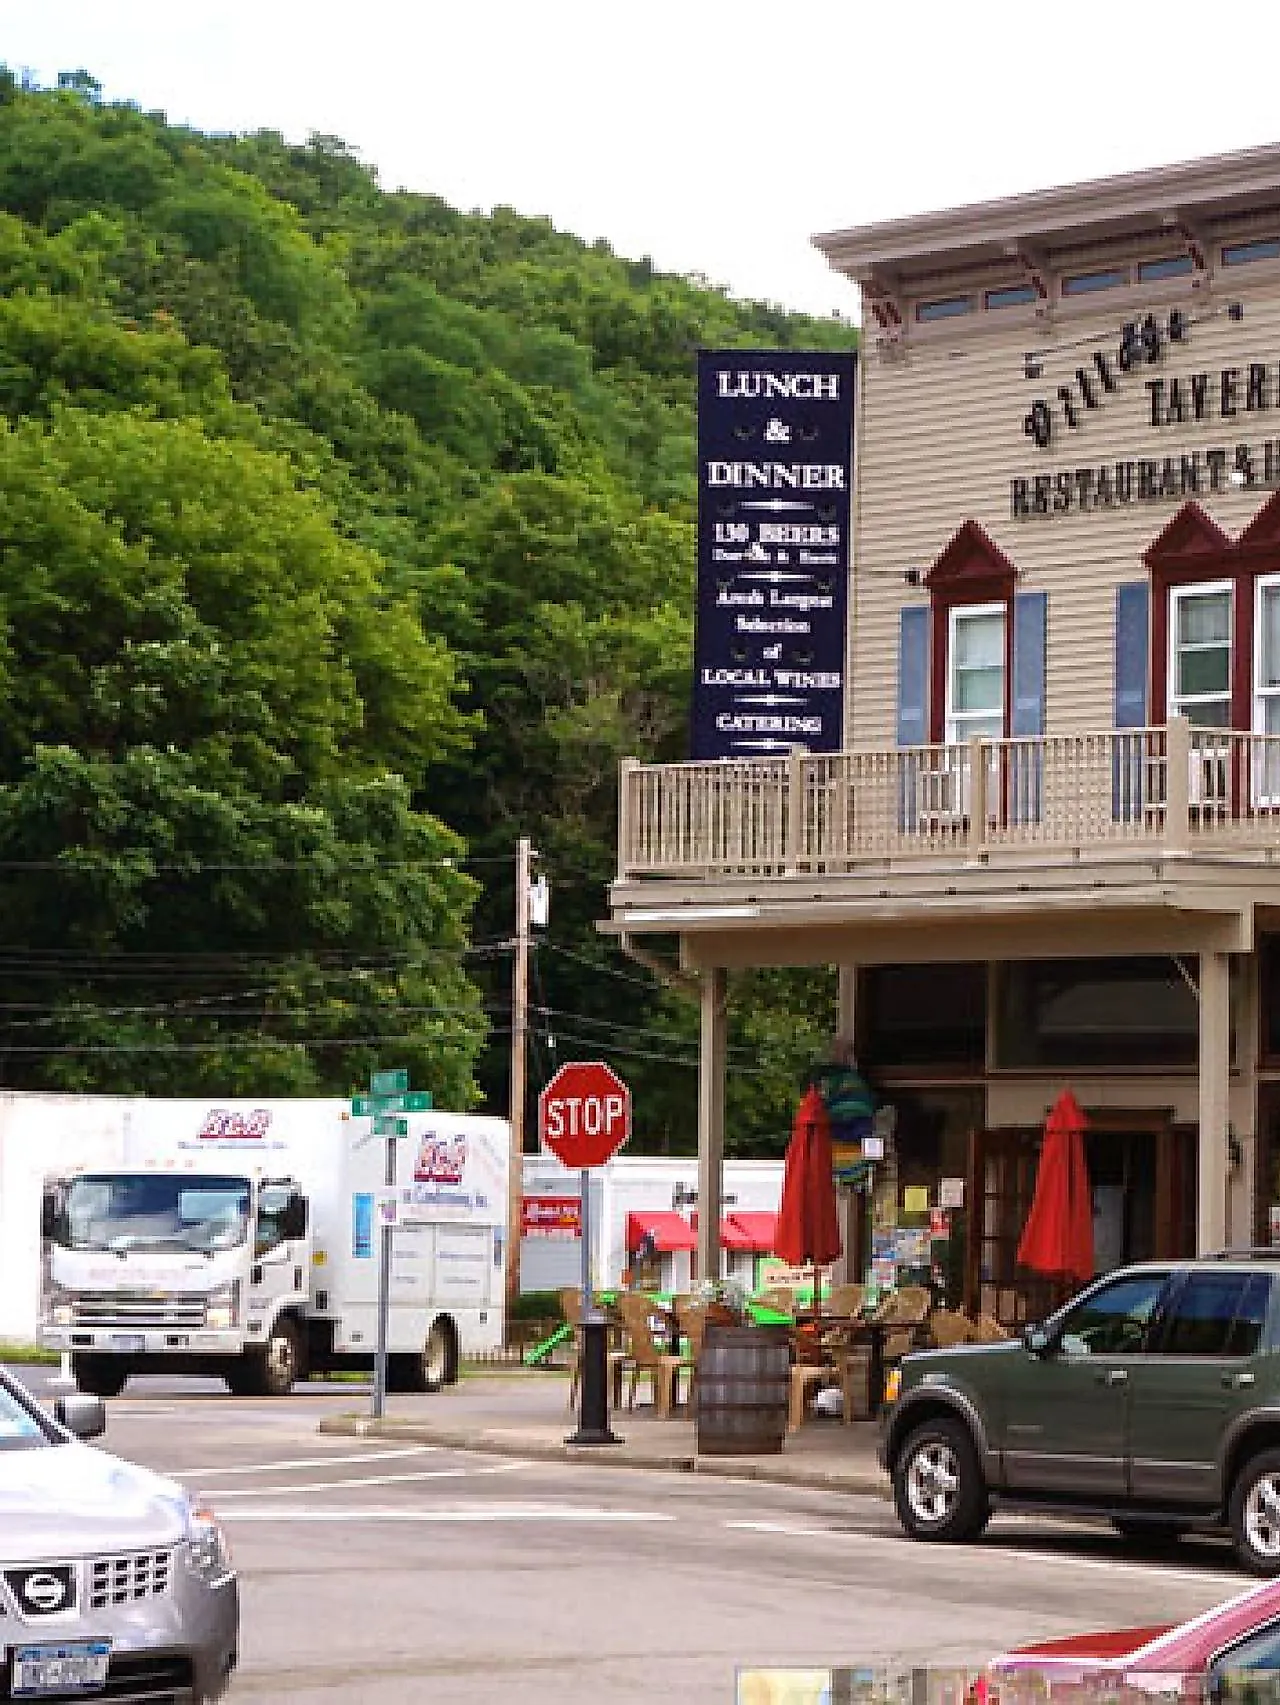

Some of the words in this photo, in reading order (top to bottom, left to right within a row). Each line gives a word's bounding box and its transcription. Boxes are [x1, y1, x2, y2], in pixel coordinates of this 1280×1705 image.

[716, 370, 841, 400] LUNCH
[763, 418, 793, 445] &
[705, 461, 847, 491] DINNER
[1010, 449, 1228, 520] RESTAURANT
[758, 523, 841, 546] BEERS
[734, 613, 812, 634] Selection
[761, 643, 784, 660] of
[701, 668, 772, 688] LOCAL
[773, 669, 842, 689] WINES
[715, 712, 823, 736] CATERING
[547, 1095, 623, 1139] STOP
